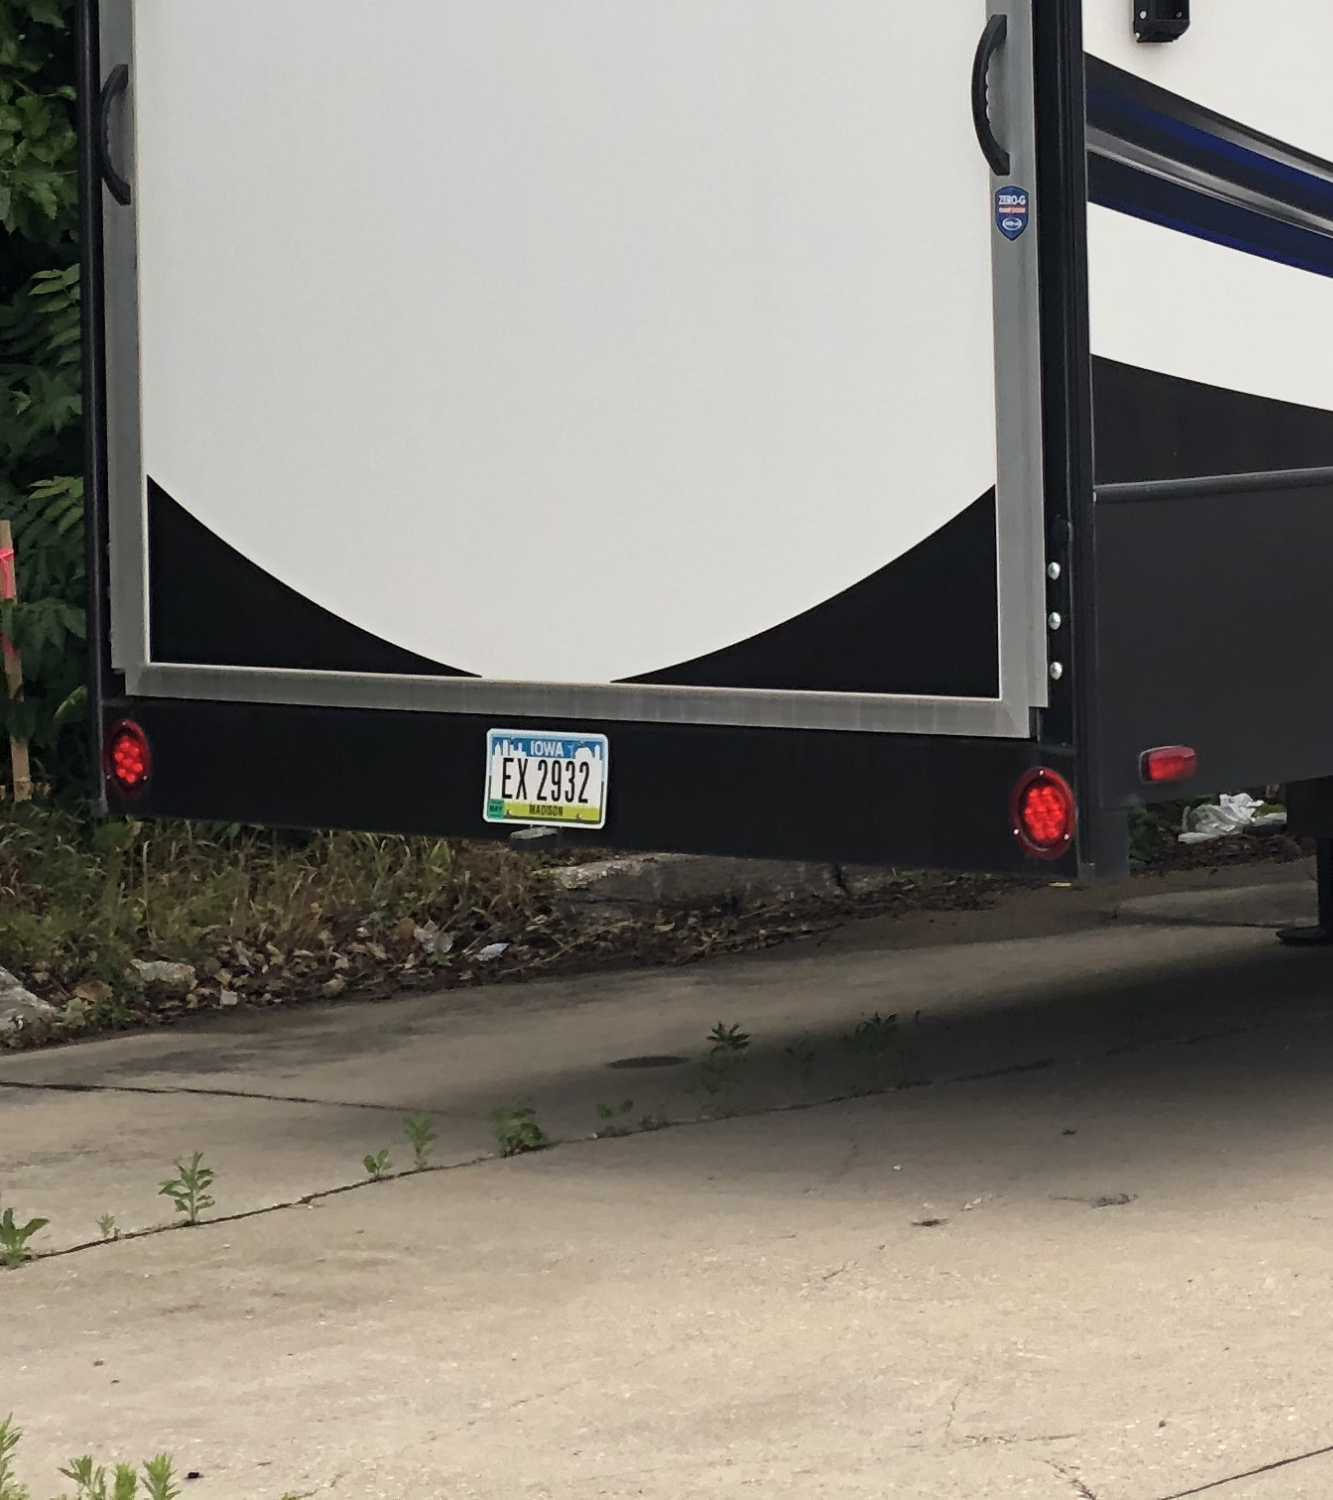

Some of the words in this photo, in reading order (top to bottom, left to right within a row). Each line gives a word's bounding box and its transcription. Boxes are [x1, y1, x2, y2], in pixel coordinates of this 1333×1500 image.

[998, 194, 1026, 205] ZERO-G
[530, 741, 564, 757] IOWA
[501, 757, 529, 801] EX
[537, 759, 590, 804] 2932
[529, 804, 563, 816] MADISON
